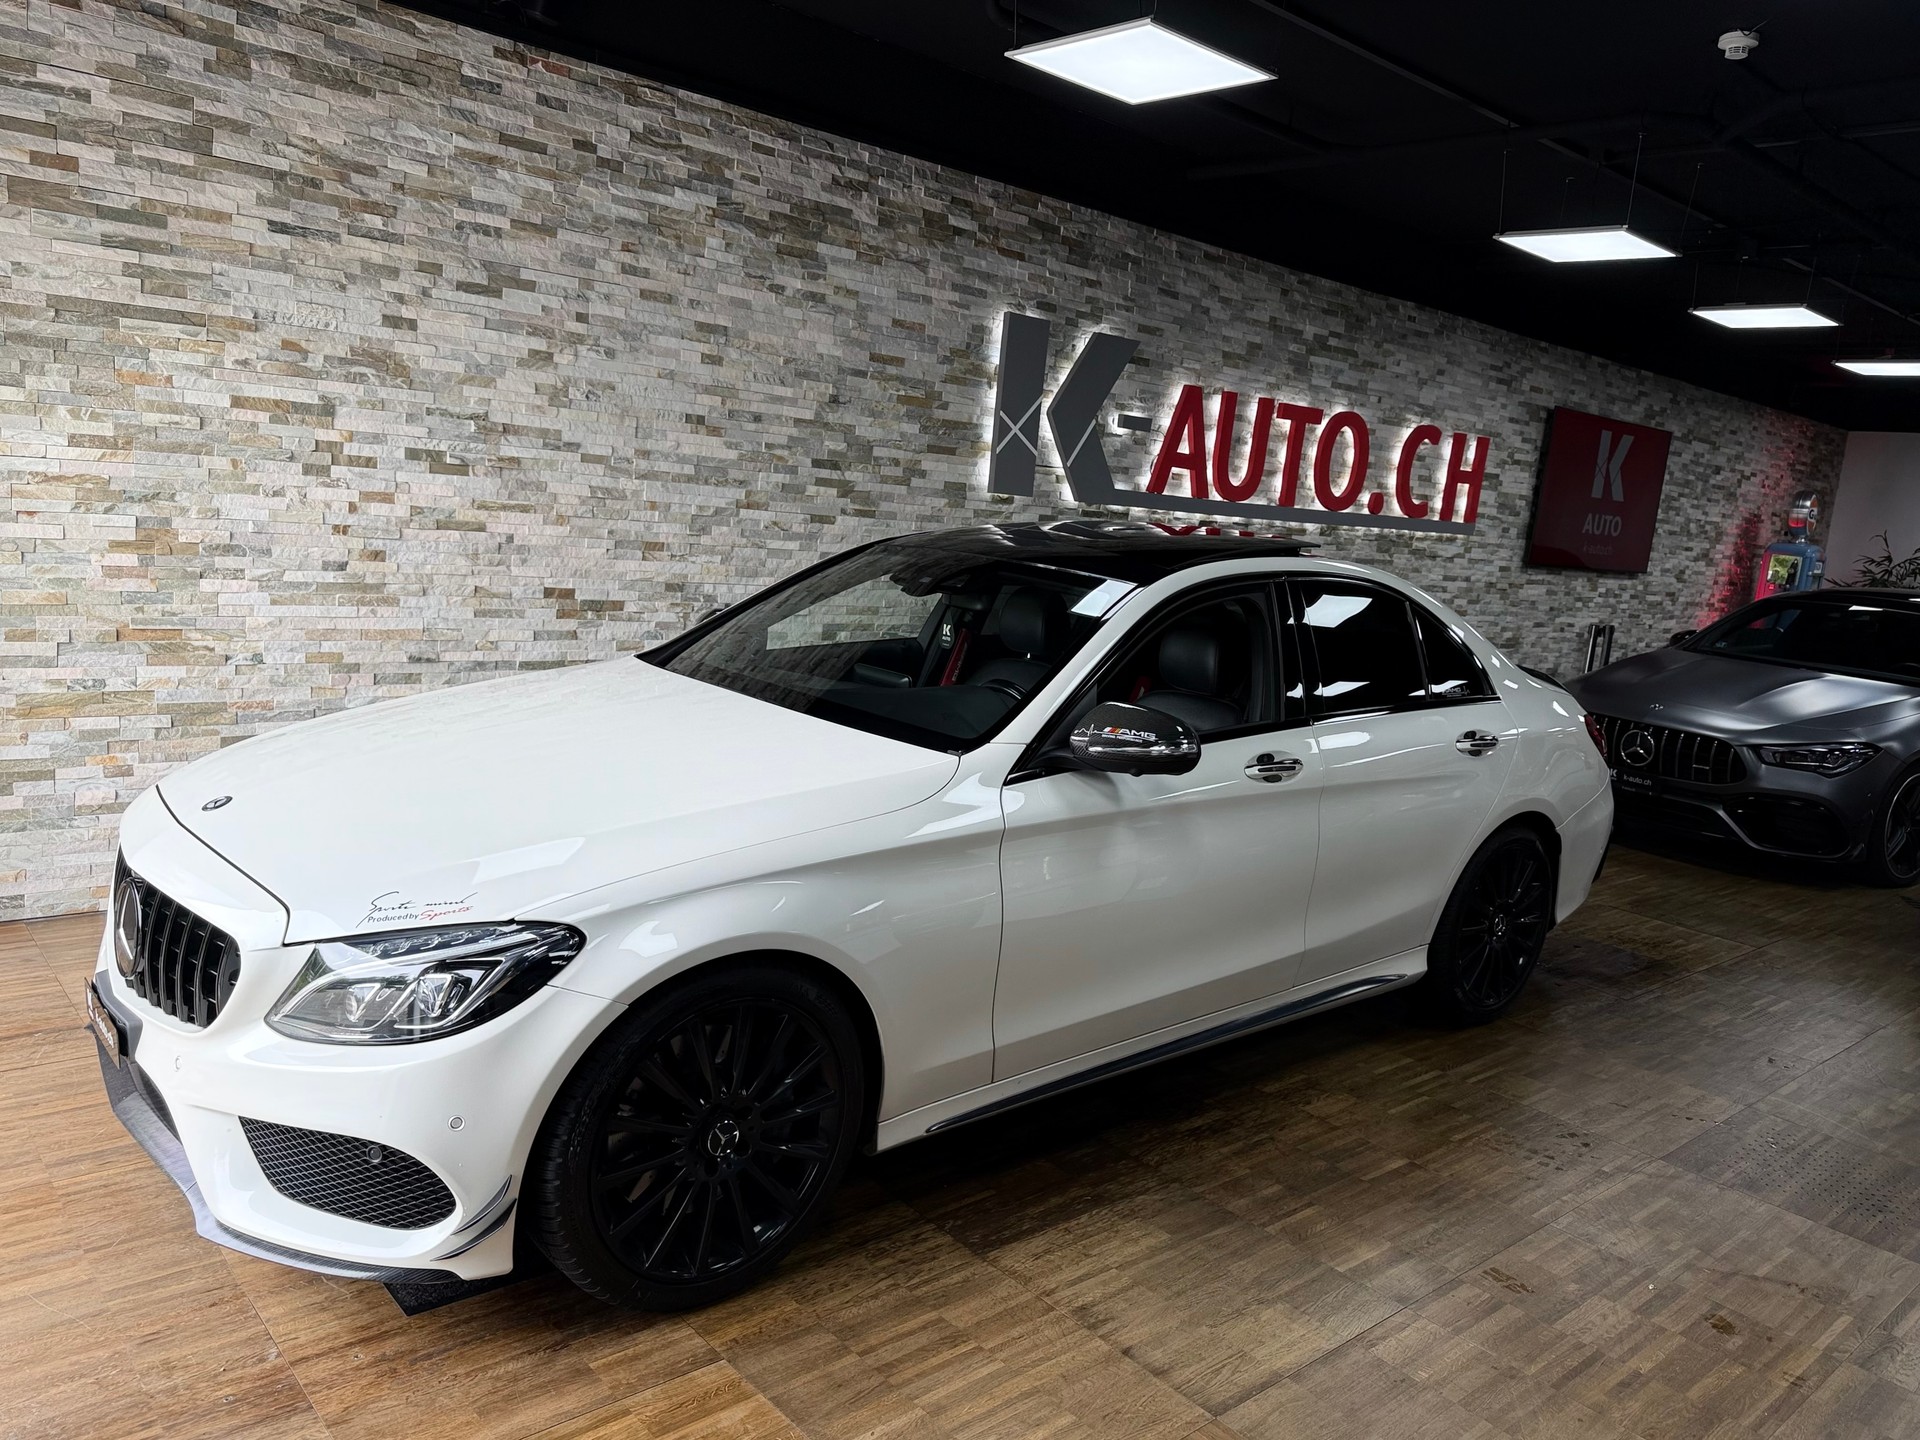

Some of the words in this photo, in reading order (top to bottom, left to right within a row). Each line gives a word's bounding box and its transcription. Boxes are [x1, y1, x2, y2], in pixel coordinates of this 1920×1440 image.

[1591, 430, 1635, 502] K
[1582, 512, 1623, 537] AUTO
[943, 624, 951, 635] K
[1119, 728, 1157, 742] AMG
[1623, 774, 1652, 786] k-auto.ch
[367, 913, 409, 923] Produced
[420, 906, 474, 920] Sports
